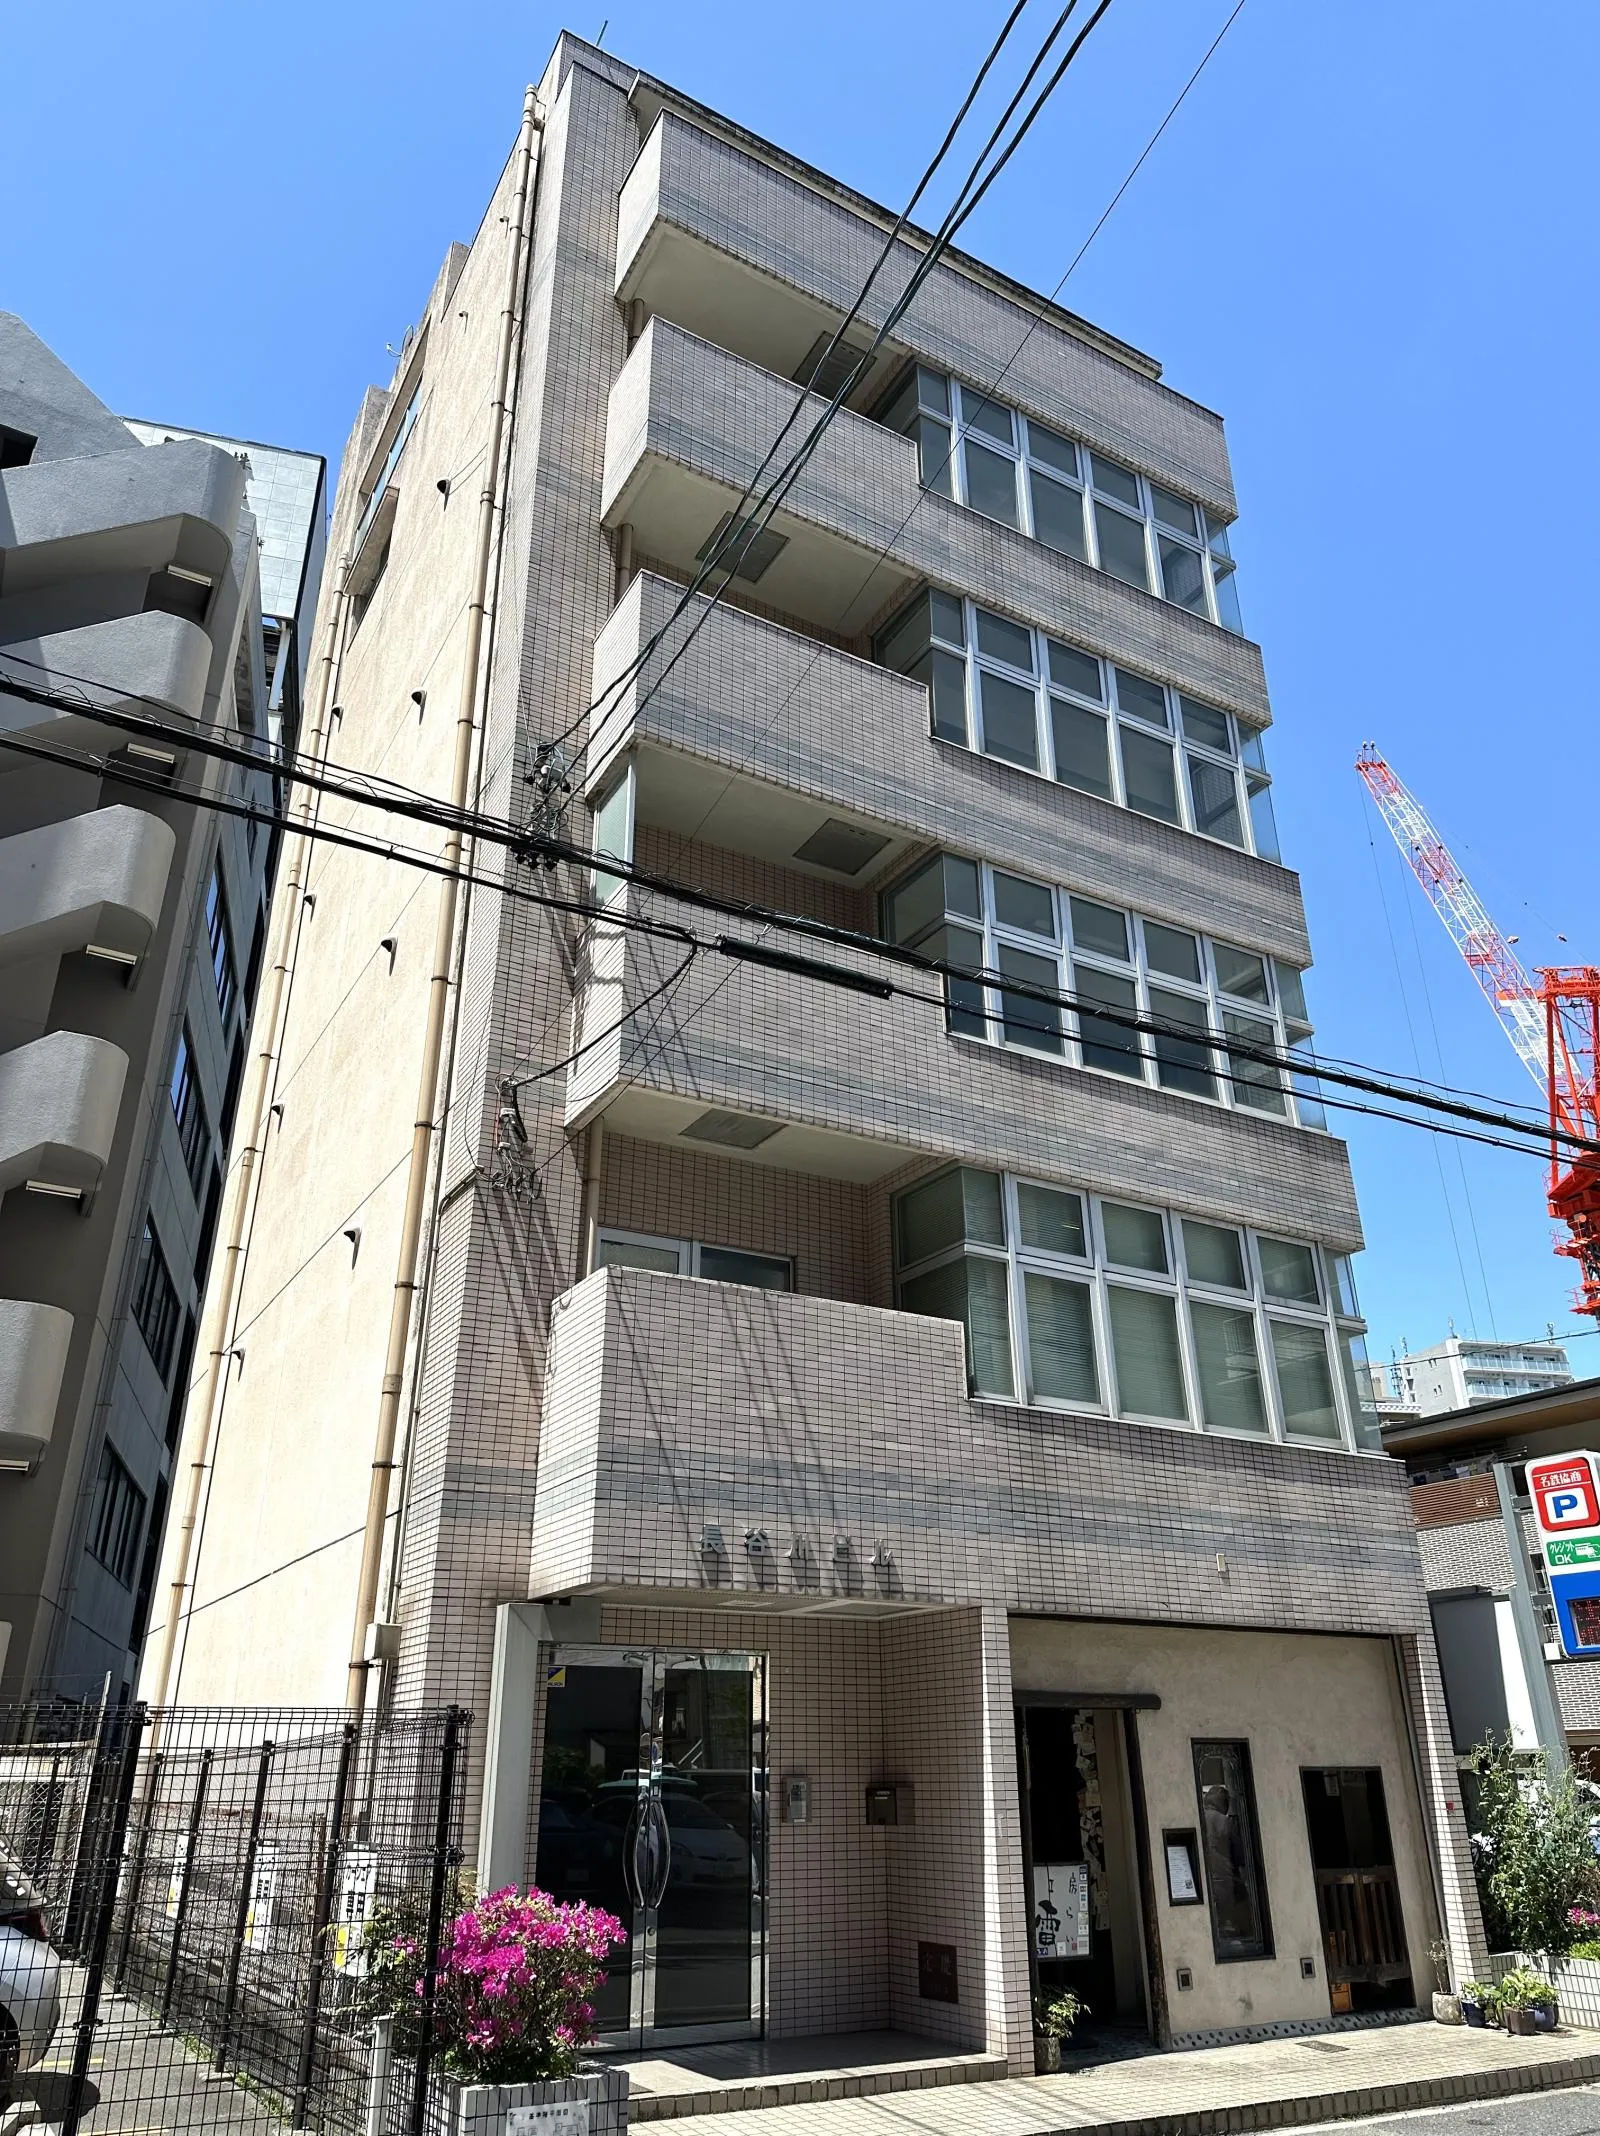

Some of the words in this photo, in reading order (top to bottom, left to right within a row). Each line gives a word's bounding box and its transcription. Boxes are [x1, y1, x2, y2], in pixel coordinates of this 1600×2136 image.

[1540, 1471, 1582, 1488] 名鉄協商
[1552, 1494, 1578, 1519] P
[700, 1524, 893, 1565] 長谷川ビル
[1555, 1554, 1574, 1565] OK
